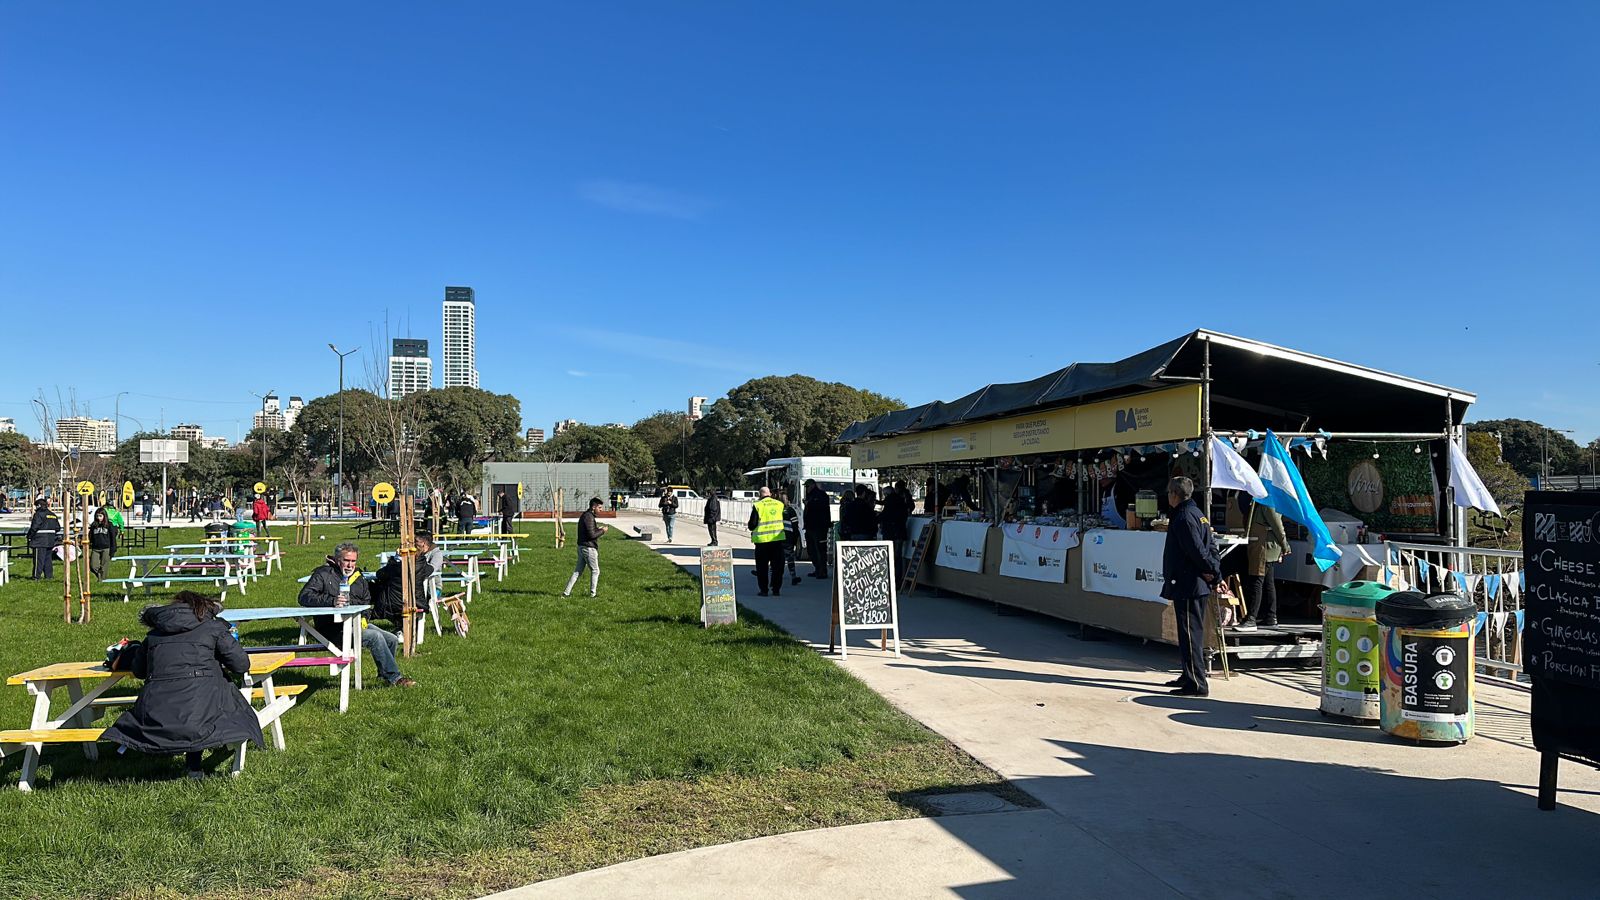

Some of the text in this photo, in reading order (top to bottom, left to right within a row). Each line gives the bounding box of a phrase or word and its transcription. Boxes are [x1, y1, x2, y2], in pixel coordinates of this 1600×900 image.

[1116, 408, 1137, 433] BA
[1138, 420, 1152, 428] Ciudad
[842, 547, 888, 578] Sandwich
[871, 564, 880, 573] de
[1038, 556, 1047, 566] BA
[1540, 548, 1596, 575] CHEESE
[844, 572, 874, 594] Pernil
[1136, 568, 1148, 582] BA
[862, 610, 888, 624] $1800
[1541, 617, 1598, 644] GIRGOLAS
[1404, 642, 1418, 706] BASURA
